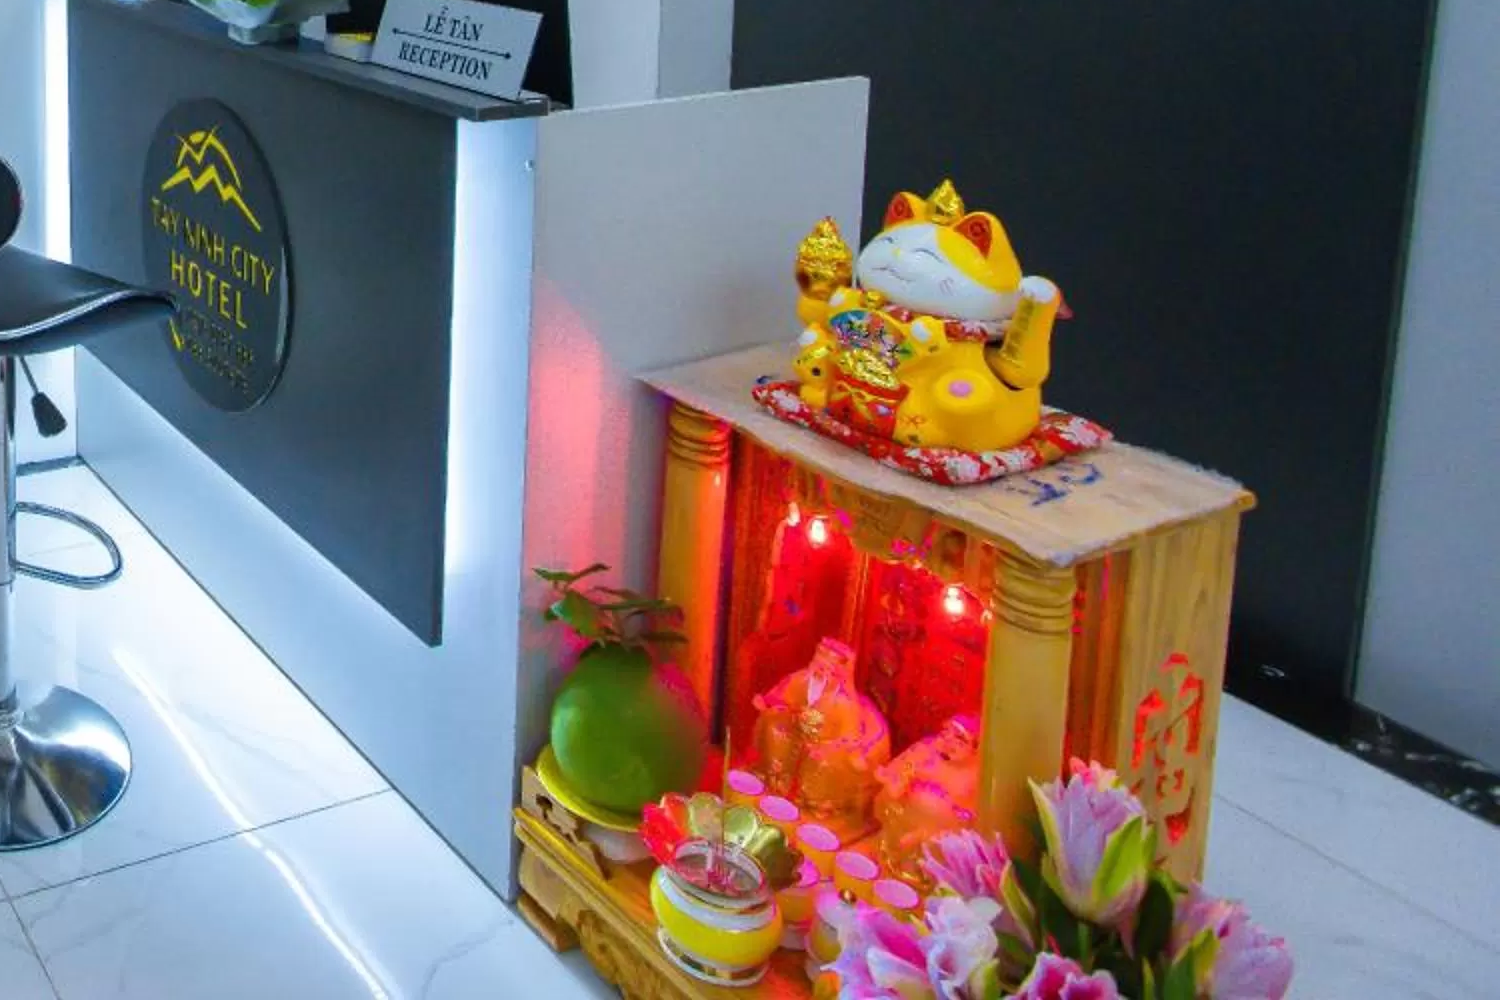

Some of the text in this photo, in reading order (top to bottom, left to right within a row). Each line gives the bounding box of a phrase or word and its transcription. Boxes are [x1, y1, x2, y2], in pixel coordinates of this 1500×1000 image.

[449, 15, 485, 41] TÂN
[398, 40, 494, 81] RECEPTION
[171, 249, 248, 330] HOTEL
[231, 245, 275, 296] CITY
